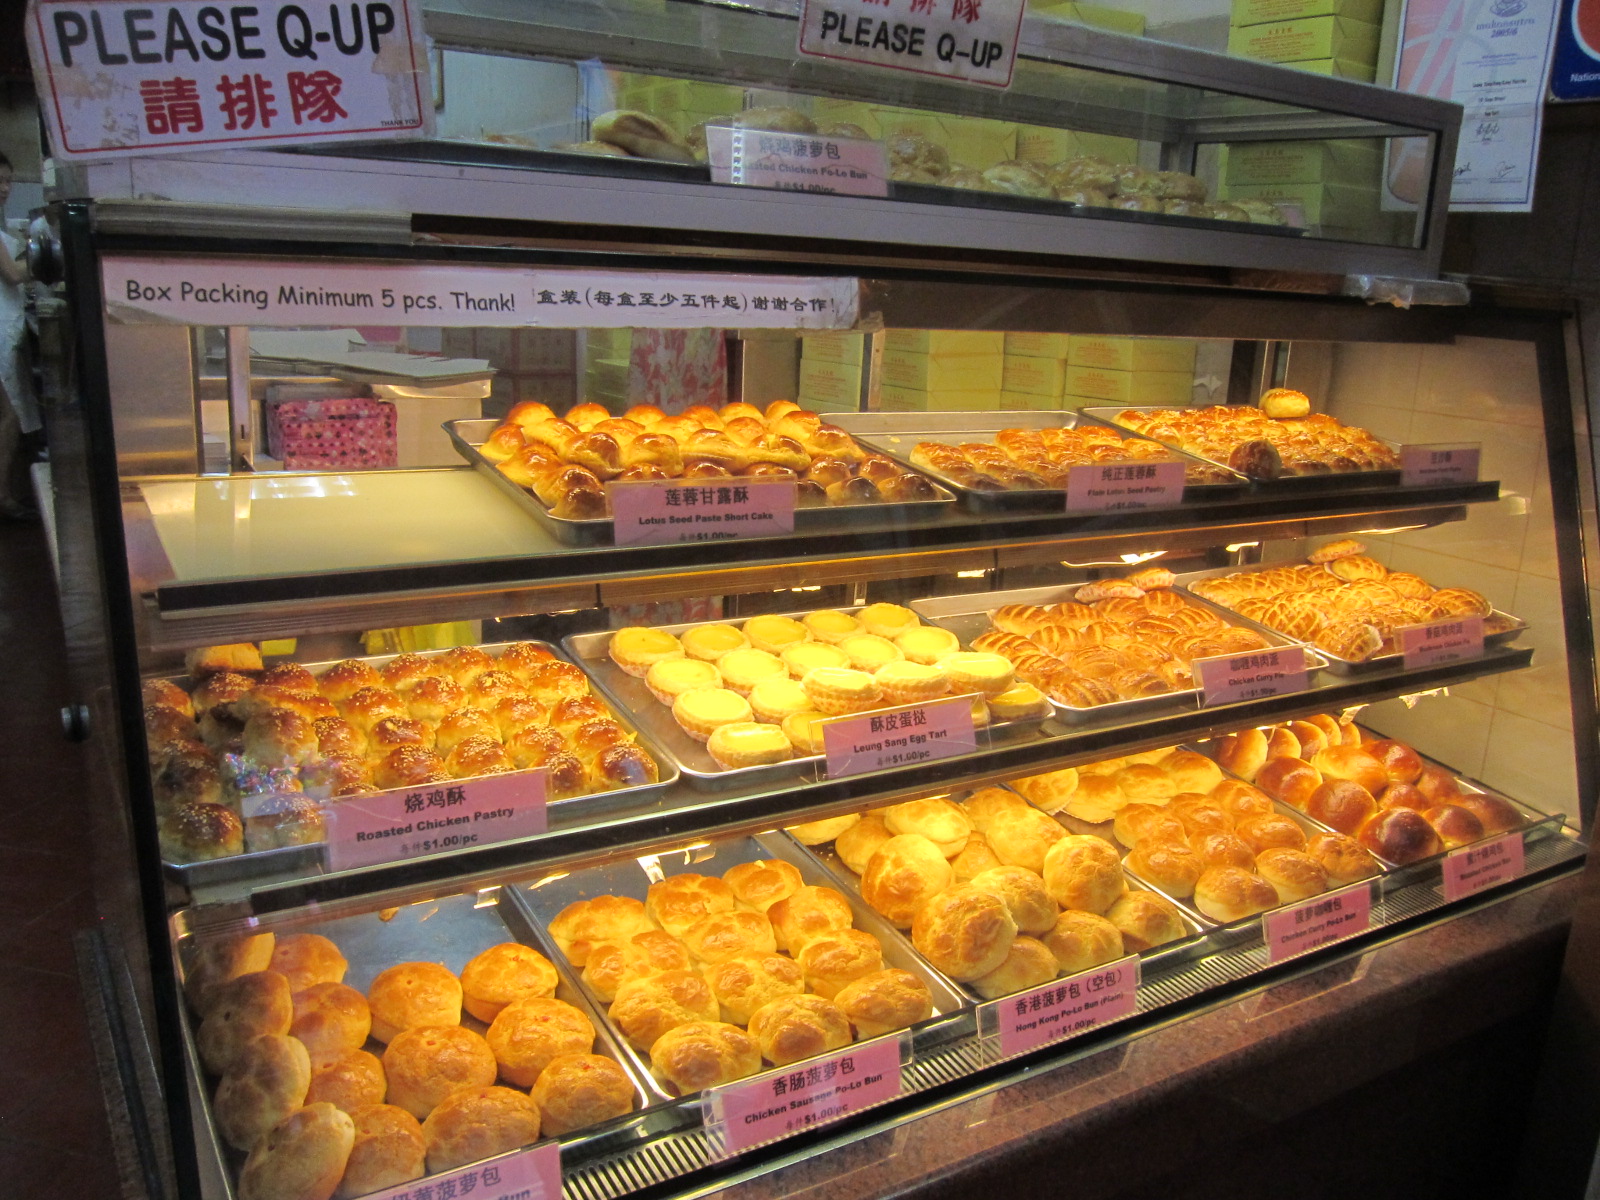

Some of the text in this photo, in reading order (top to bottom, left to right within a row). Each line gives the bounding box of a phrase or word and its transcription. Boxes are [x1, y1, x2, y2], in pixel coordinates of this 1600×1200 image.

[53, 3, 395, 68] PLEASE Q-UP
[820, 10, 1003, 69] PLEASE Q-UP
[140, 70, 348, 135] 請排隊
[779, 163, 818, 175] Chicken
[850, 170, 868, 179] Bun
[126, 279, 515, 313] Box Packing Minimum 5 pcs. Thank!
[665, 486, 749, 506] 莲蓉甘露酥
[639, 512, 774, 525] Lotus Seed Paste Short Cake
[1229, 676, 1254, 686] Chicken
[1256, 674, 1273, 682] Curry
[870, 708, 927, 733] 酥皮蛋挞
[853, 729, 947, 754] Leung Sang Egg Tart
[404, 785, 466, 814] 烧鸡酥
[356, 807, 514, 842] Roasted Chicken Pastry
[1281, 930, 1307, 943] Chicken
[1308, 924, 1325, 934] Curry
[1344, 913, 1356, 921] Bun
[1015, 992, 1124, 1032] Hong Kong Po-Lo Bun (Plain)
[772, 1057, 855, 1097] 香肠菠萝包
[744, 1073, 882, 1124] Chicken Sausage Po-Lo Bun
